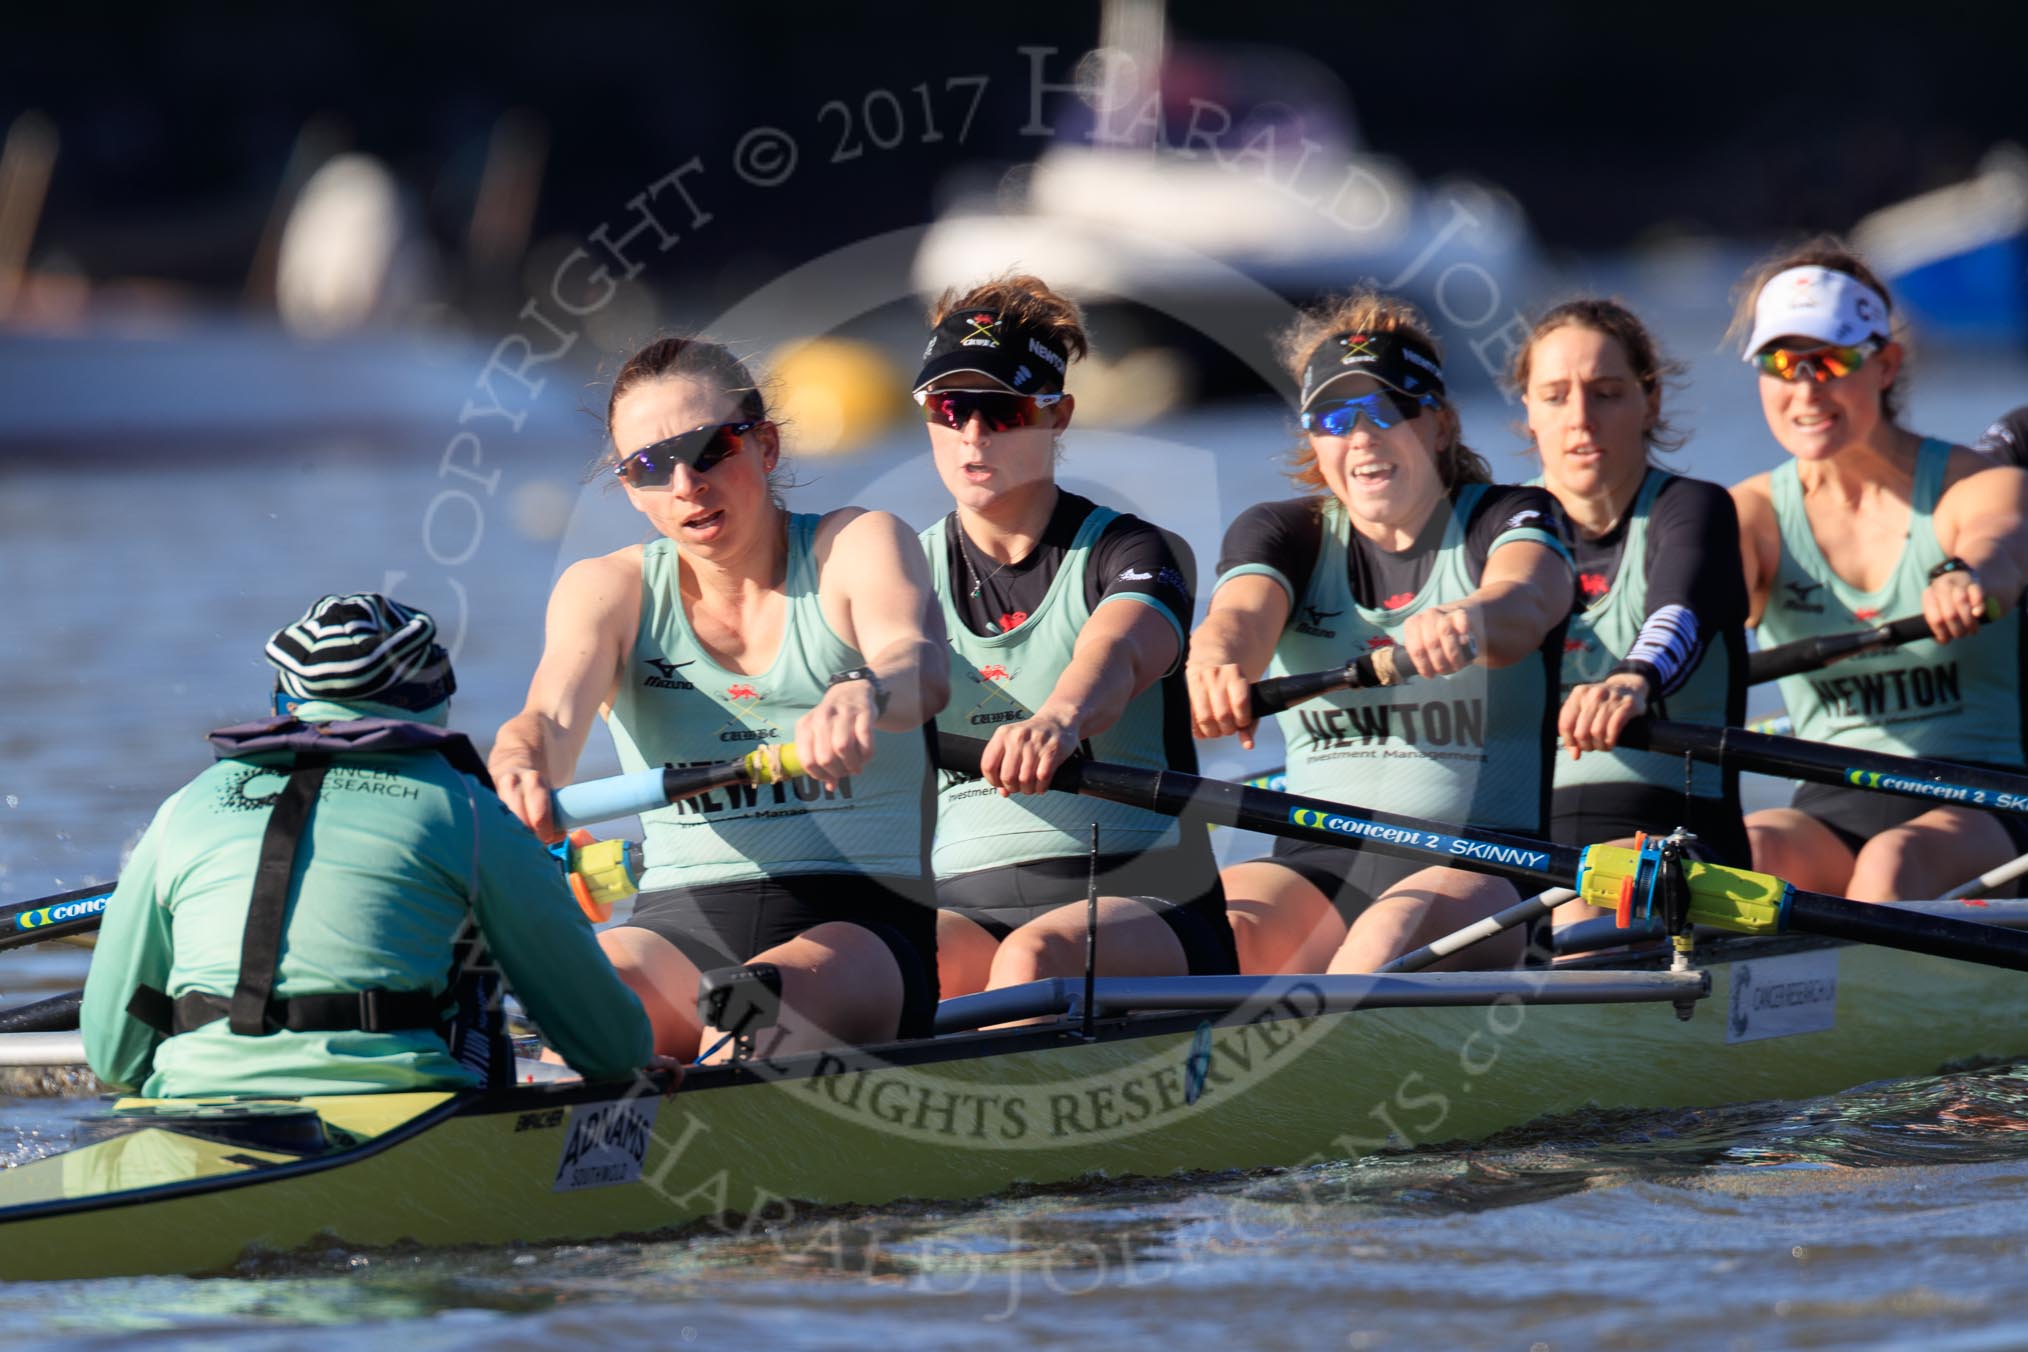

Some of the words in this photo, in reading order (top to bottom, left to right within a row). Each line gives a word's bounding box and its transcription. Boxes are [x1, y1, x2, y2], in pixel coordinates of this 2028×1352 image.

[1810, 660, 1962, 719] NEWTON
[1299, 698, 1485, 752] NEWTON
[322, 777, 420, 801] ESEARCH
[325, 765, 399, 782] ANCER
[1882, 777, 1968, 800] concept
[1973, 790, 1986, 804] 2
[1328, 817, 1420, 845] concept
[1425, 834, 1440, 850] 2
[1448, 838, 1546, 869] SKINNY
[556, 1104, 650, 1182] ADNAMS
